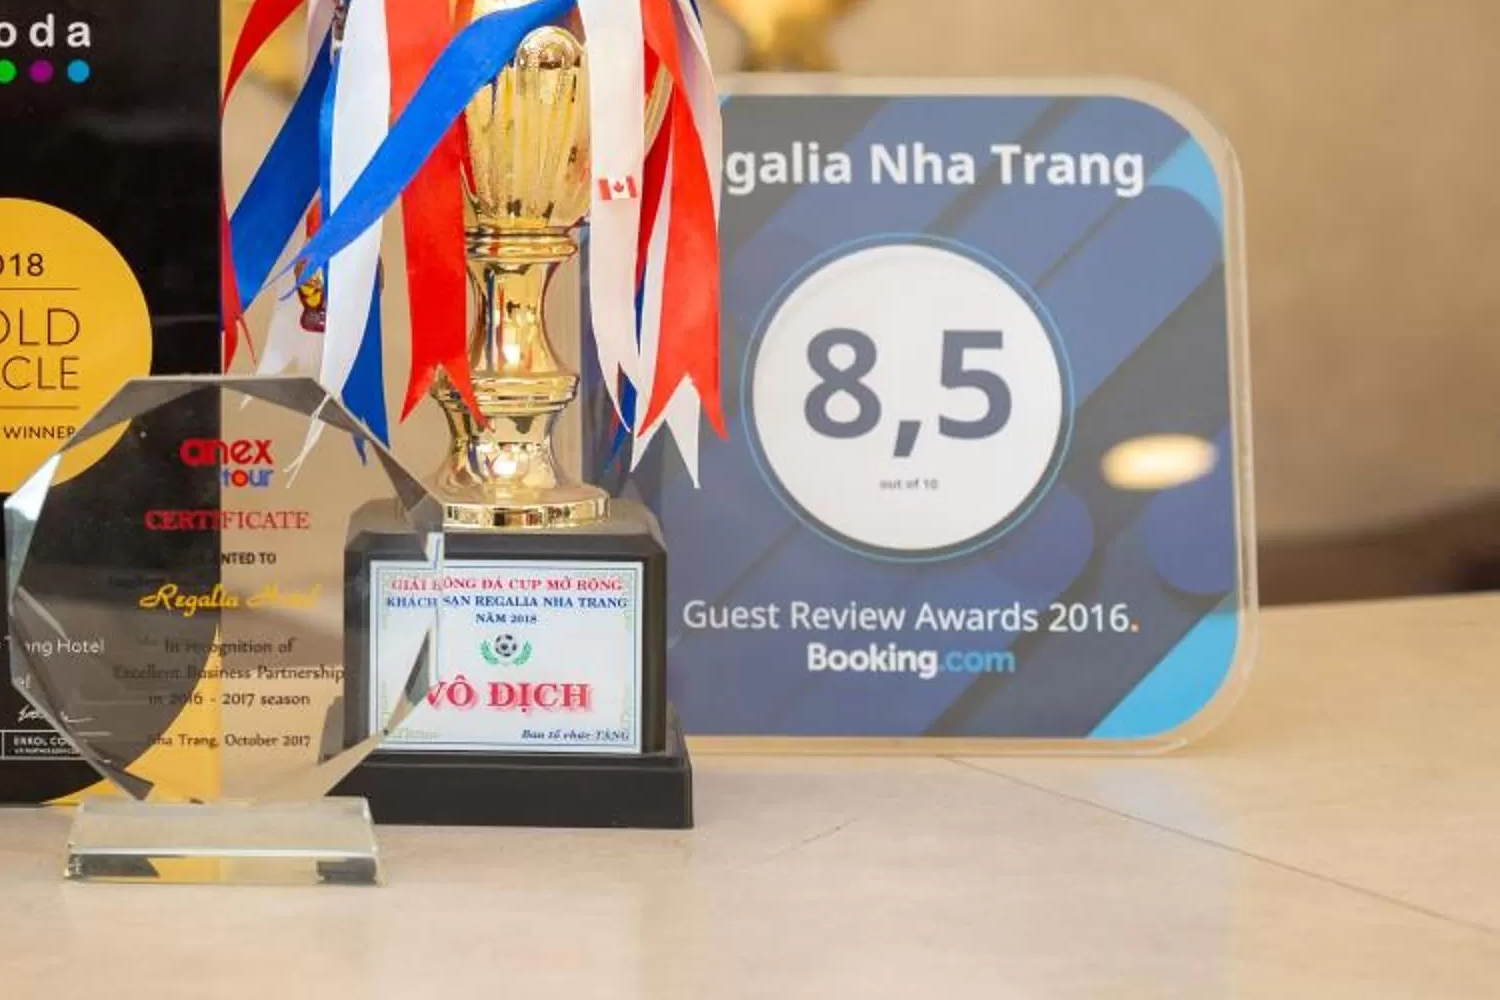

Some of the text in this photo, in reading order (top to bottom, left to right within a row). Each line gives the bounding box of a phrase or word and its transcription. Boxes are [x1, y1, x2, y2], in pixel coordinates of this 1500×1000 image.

[725, 140, 1145, 198] galia Nha Trang
[803, 326, 1013, 458] 8,5
[179, 438, 274, 466] anex
[218, 466, 274, 489] tour
[144, 509, 311, 531] CERTIFICATE
[258, 551, 277, 564] TO
[475, 595, 538, 607] REGALIA
[543, 596, 574, 608] NHA
[579, 597, 628, 609] TRANG
[682, 600, 1140, 633] Guest Review Awards 2016.
[57, 637, 105, 653] Hotel
[185, 638, 273, 657] reognition
[278, 637, 298, 652] of
[807, 642, 1016, 679] Booking.com
[257, 664, 345, 684] Partnership
[222, 692, 256, 705] 2017
[260, 694, 311, 705] season
[224, 733, 280, 747] October
[283, 735, 311, 748] 2017
